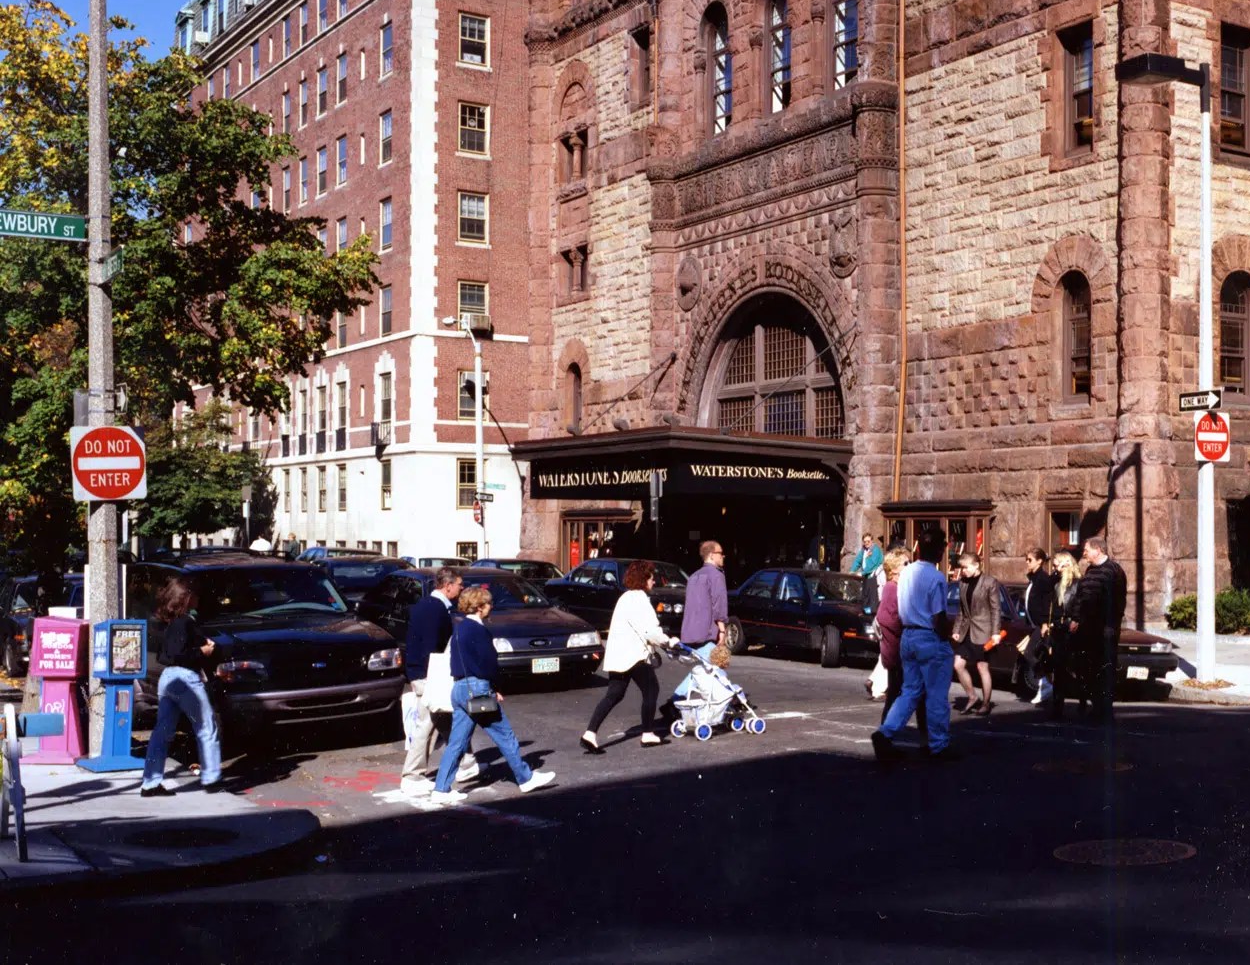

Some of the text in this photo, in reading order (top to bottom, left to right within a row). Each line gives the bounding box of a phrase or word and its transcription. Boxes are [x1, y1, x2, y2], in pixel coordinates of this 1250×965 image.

[63, 226, 75, 237] ST
[1183, 396, 1208, 406] ONE WAY
[1201, 420, 1223, 431] DO NOT
[84, 439, 131, 454] DO NOT
[1203, 442, 1222, 452] ENTER
[690, 464, 784, 479] WATERSTONE'S
[90, 472, 130, 487] ENTER
[538, 468, 619, 488] WATERSTONES
[115, 630, 140, 638] FREE
[39, 660, 74, 669] FOR SALE
